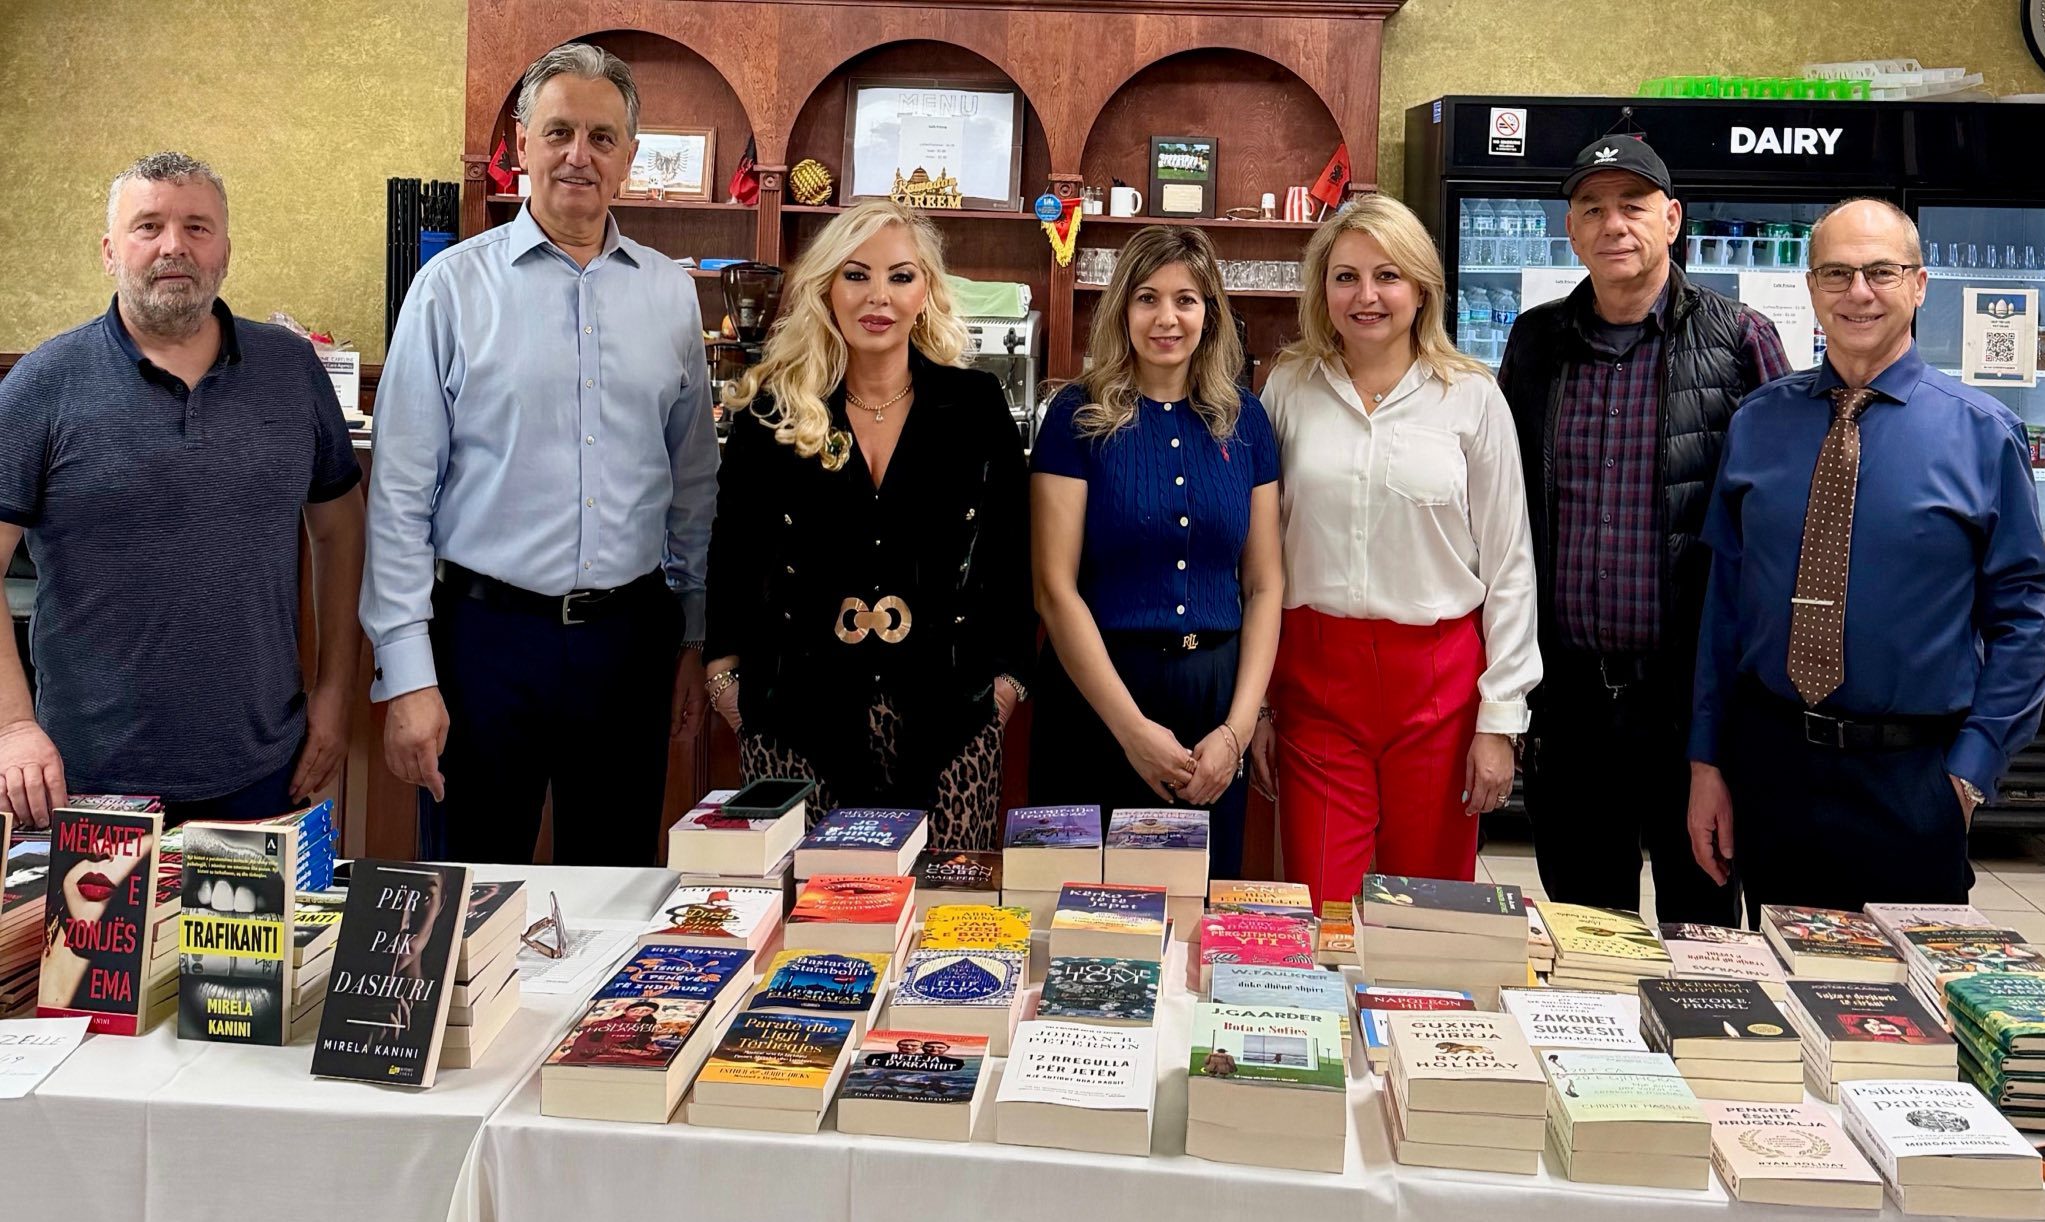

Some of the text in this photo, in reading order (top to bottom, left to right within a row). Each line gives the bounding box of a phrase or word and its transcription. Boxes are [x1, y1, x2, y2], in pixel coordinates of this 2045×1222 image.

[898, 94, 979, 116] MENU
[1730, 126, 1843, 155] DAIRY
[890, 194, 964, 210] KAREEM
[59, 817, 146, 857] MËKATET
[128, 874, 140, 906] E
[376, 885, 421, 912] PËR
[64, 917, 137, 954] ZONJËS
[183, 919, 278, 954] TRAFIKANTI
[370, 931, 417, 955] PAK
[1236, 936, 1281, 947] YTI
[1692, 964, 1744, 974] WILMS
[90, 969, 132, 1002] EMA
[334, 971, 435, 1001] DASHURI
[1069, 971, 1140, 985] TOM
[207, 997, 253, 1017] MIRELA
[1374, 996, 1461, 1007] NAPOLEON
[1212, 1007, 1323, 1023] J.GAARDER
[1530, 1013, 1616, 1025] ZAKONET
[208, 1019, 251, 1038] KANINI
[1224, 1022, 1254, 1032] Bota
[1412, 1022, 1494, 1030] GUXIMI
[1534, 1025, 1625, 1037] SUKSESIT
[1411, 1032, 1503, 1040] THIRRJA
[324, 1040, 419, 1059] MIRELA KANINI
[889, 1053, 941, 1063] BETEJA
[1028, 1053, 1130, 1068] 12 RREGULLA
[1416, 1061, 1520, 1070] HOLIDAY
[1035, 1064, 1066, 1073] PËR
[1873, 1099, 1975, 1111] parasë
